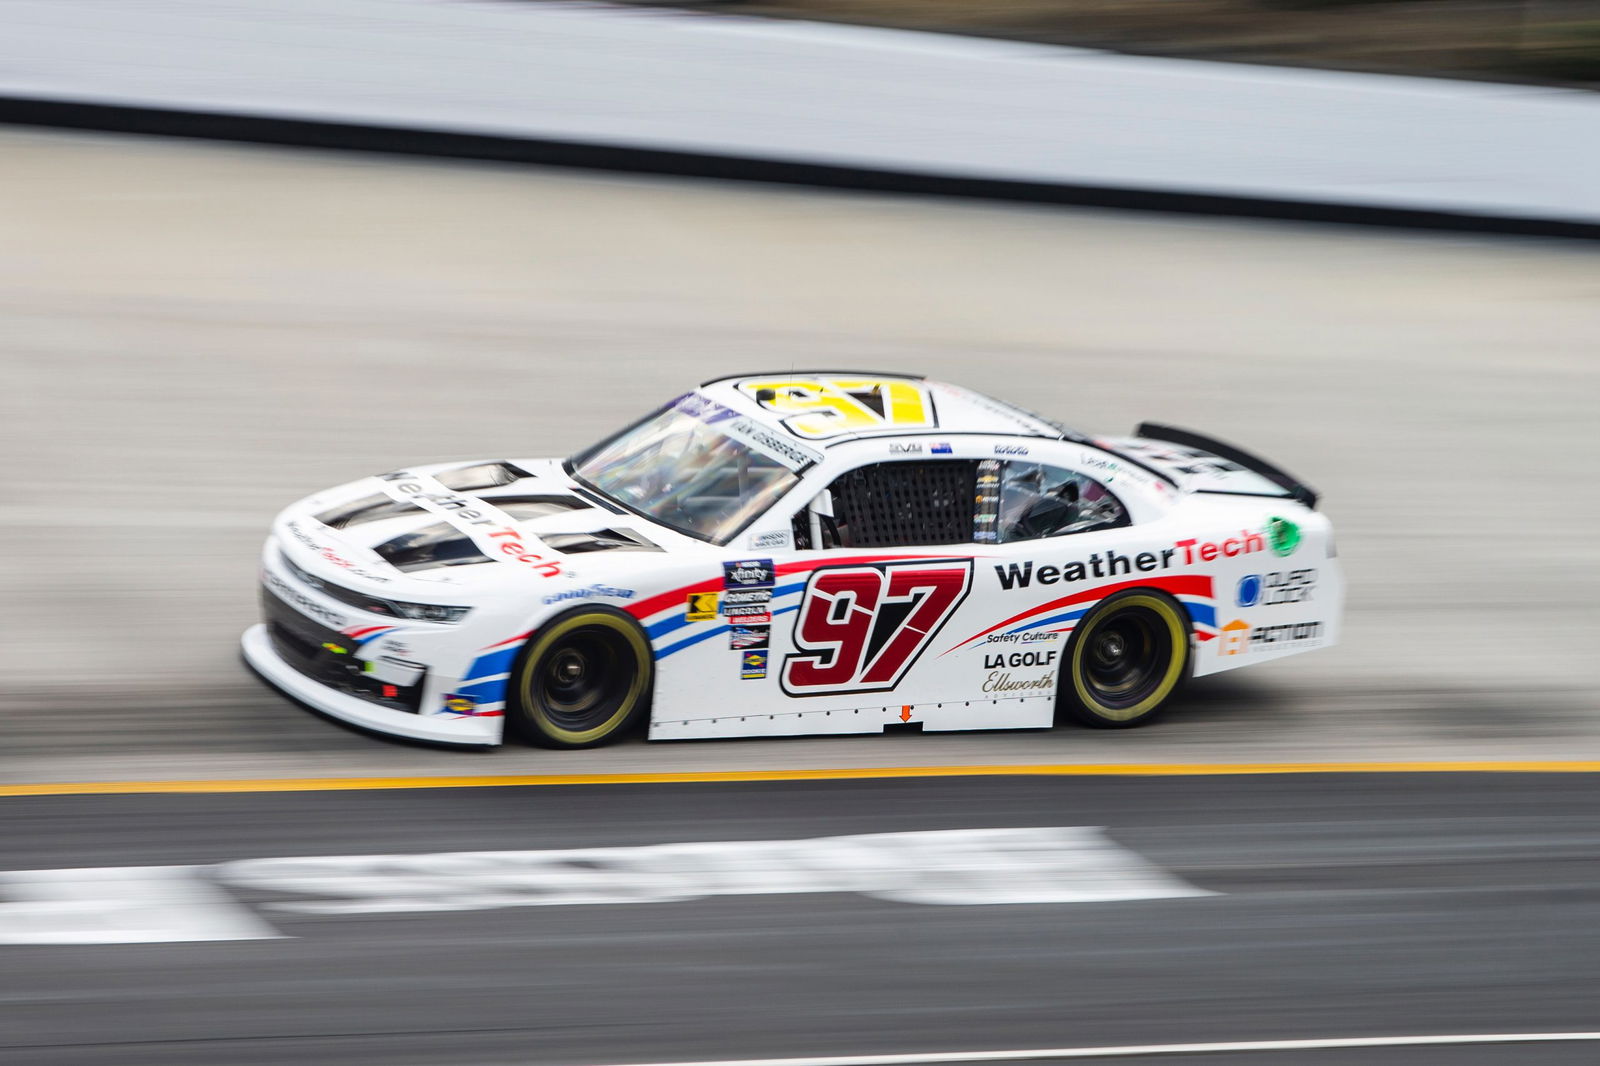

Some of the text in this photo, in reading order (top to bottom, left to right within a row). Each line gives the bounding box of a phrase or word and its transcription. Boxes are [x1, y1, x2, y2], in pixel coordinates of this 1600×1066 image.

[994, 528, 1265, 590] WeatherTech
[730, 567, 768, 582] xfinity
[724, 605, 766, 616] LINCOLN
[784, 562, 970, 692] 97
[987, 632, 1058, 644] Safety Culture
[984, 651, 1057, 669] LA GOLF
[982, 670, 1055, 693] Ellsworth
